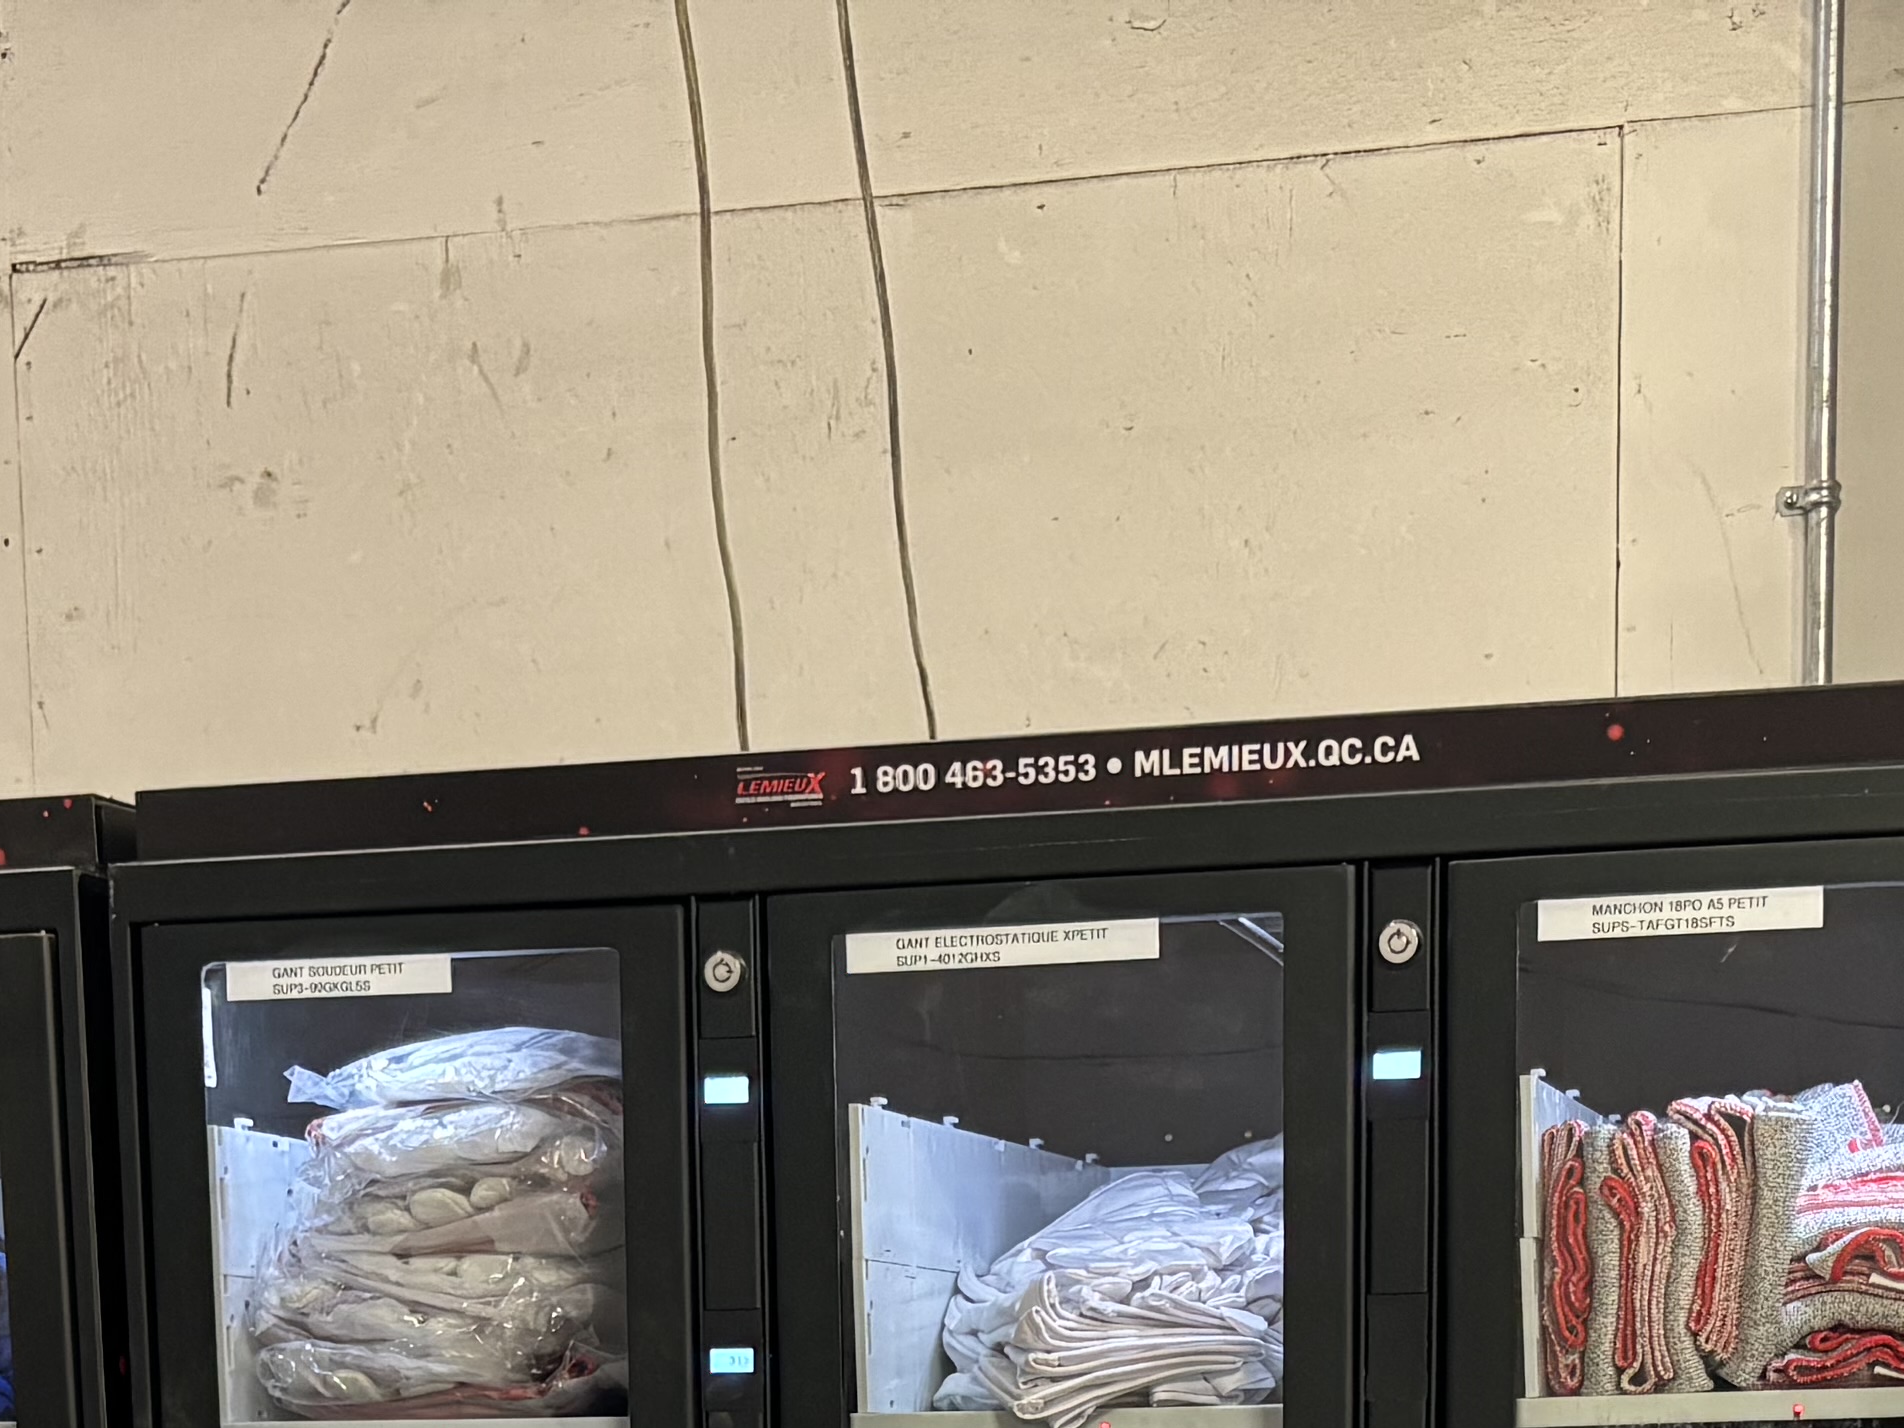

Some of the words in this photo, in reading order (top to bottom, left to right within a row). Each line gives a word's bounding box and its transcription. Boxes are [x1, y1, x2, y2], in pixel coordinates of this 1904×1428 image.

[850, 766, 866, 795] 1
[877, 762, 936, 793] 800
[945, 754, 1097, 789] 463-5353
[1134, 733, 1420, 778] MLEMIEUX.QC.CA
[737, 771, 825, 797] LEMIEUX
[1591, 901, 1664, 915] MANCHON
[1668, 898, 1703, 912] 18PO
[1707, 897, 1724, 910] A5
[1727, 895, 1769, 909] PETIT
[895, 937, 930, 949] GANT
[934, 930, 1059, 947] ELECTROSTATIQUE
[1063, 927, 1109, 940] XPETIT
[271, 966, 305, 978] GANT
[370, 962, 404, 974] PETIT
